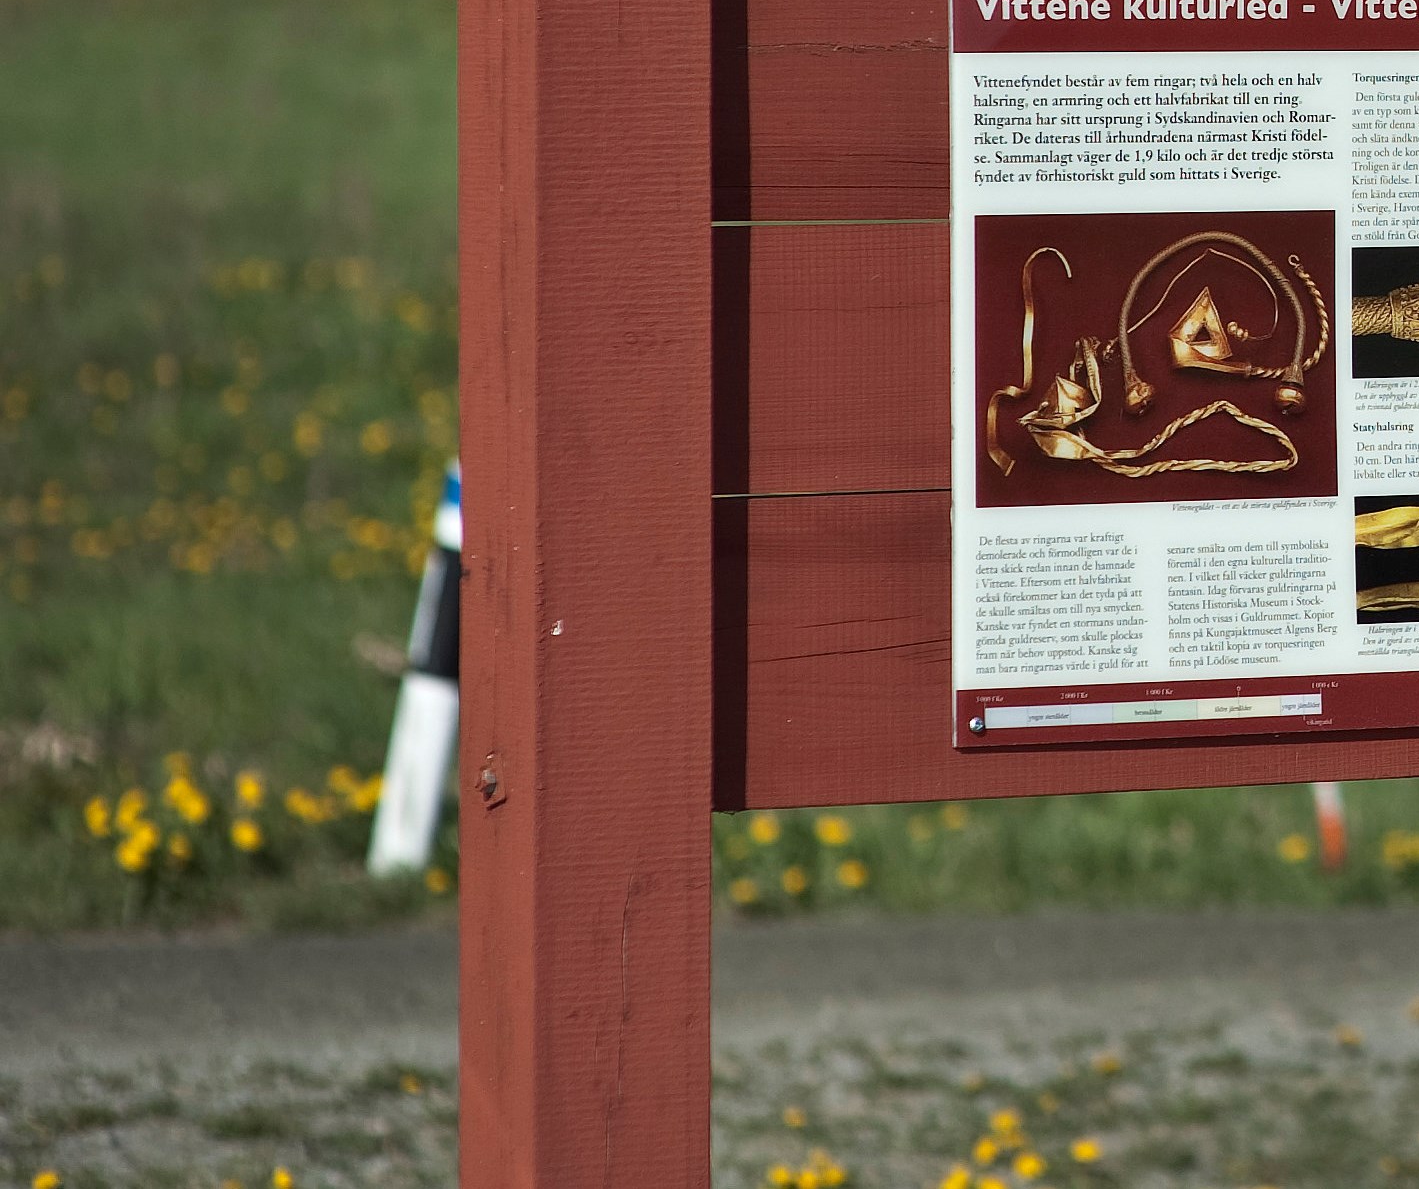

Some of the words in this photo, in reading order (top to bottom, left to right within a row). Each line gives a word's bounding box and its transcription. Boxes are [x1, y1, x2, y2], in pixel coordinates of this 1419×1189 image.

[973, 74, 1061, 91] Vittenefyndet
[1065, 74, 1105, 87] består
[1108, 78, 1121, 86] av
[1125, 73, 1149, 86] fem
[1153, 74, 1195, 90] ringar;
[1199, 73, 1217, 86] två
[1221, 73, 1247, 86] hela
[1251, 73, 1274, 85] och
[1278, 77, 1293, 85] en
[1297, 72, 1322, 85] halv
[973, 93, 1028, 110] halsring,
[1032, 97, 1047, 106] en
[1051, 93, 1103, 109] armring
[1106, 92, 1129, 105] och
[1133, 95, 1151, 105] ett
[1155, 92, 1229, 105] halvfabrikat
[1232, 91, 1249, 104] till
[1253, 96, 1269, 104] en
[1273, 91, 1301, 108] ring.
[973, 113, 1032, 129] Ringarna
[1035, 112, 1057, 125] har
[1060, 112, 1081, 124] sitt
[1084, 115, 1143, 128] ursprung
[1146, 111, 1150, 124] i
[1154, 110, 1258, 128] Sydskandinavien
[1262, 110, 1284, 123] och
[1288, 110, 1335, 122] Romar-
[974, 131, 1007, 144] riket.
[1012, 131, 1031, 144] De
[1034, 131, 1080, 144] dateras
[1084, 130, 1101, 143] till
[1105, 129, 1193, 143] århundradena
[1197, 130, 1247, 142] närmast
[1251, 128, 1286, 141] Kristi
[1291, 128, 1327, 141] födel-
[1350, 160, 1389, 173] Troligen
[1391, 161, 1401, 170] är
[1402, 160, 1418, 170] den
[1352, 421, 1413, 434] Statyhalsring
